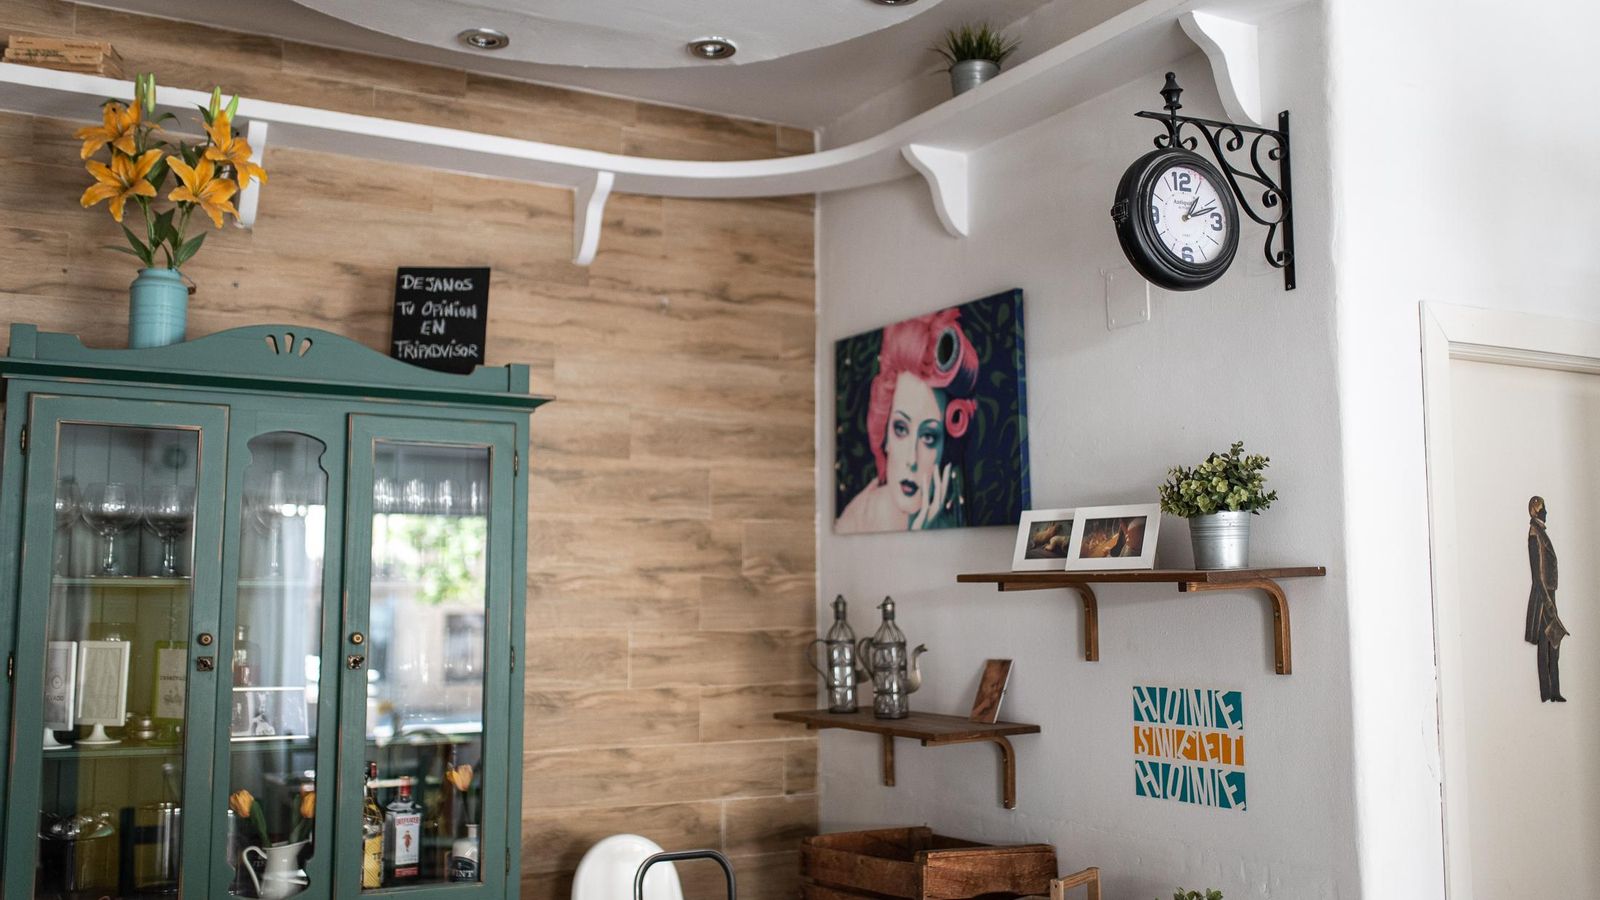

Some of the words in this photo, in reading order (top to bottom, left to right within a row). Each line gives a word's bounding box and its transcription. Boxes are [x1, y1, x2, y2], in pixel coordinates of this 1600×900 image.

[1171, 171, 1192, 192] 12
[1209, 212, 1223, 231] 3
[1181, 246, 1195, 264] 6
[397, 301, 415, 316] TU
[420, 318, 446, 336] EN
[1132, 686, 1244, 730] HOME
[1133, 726, 1245, 766] SWEET
[1134, 760, 1247, 811] HOME
